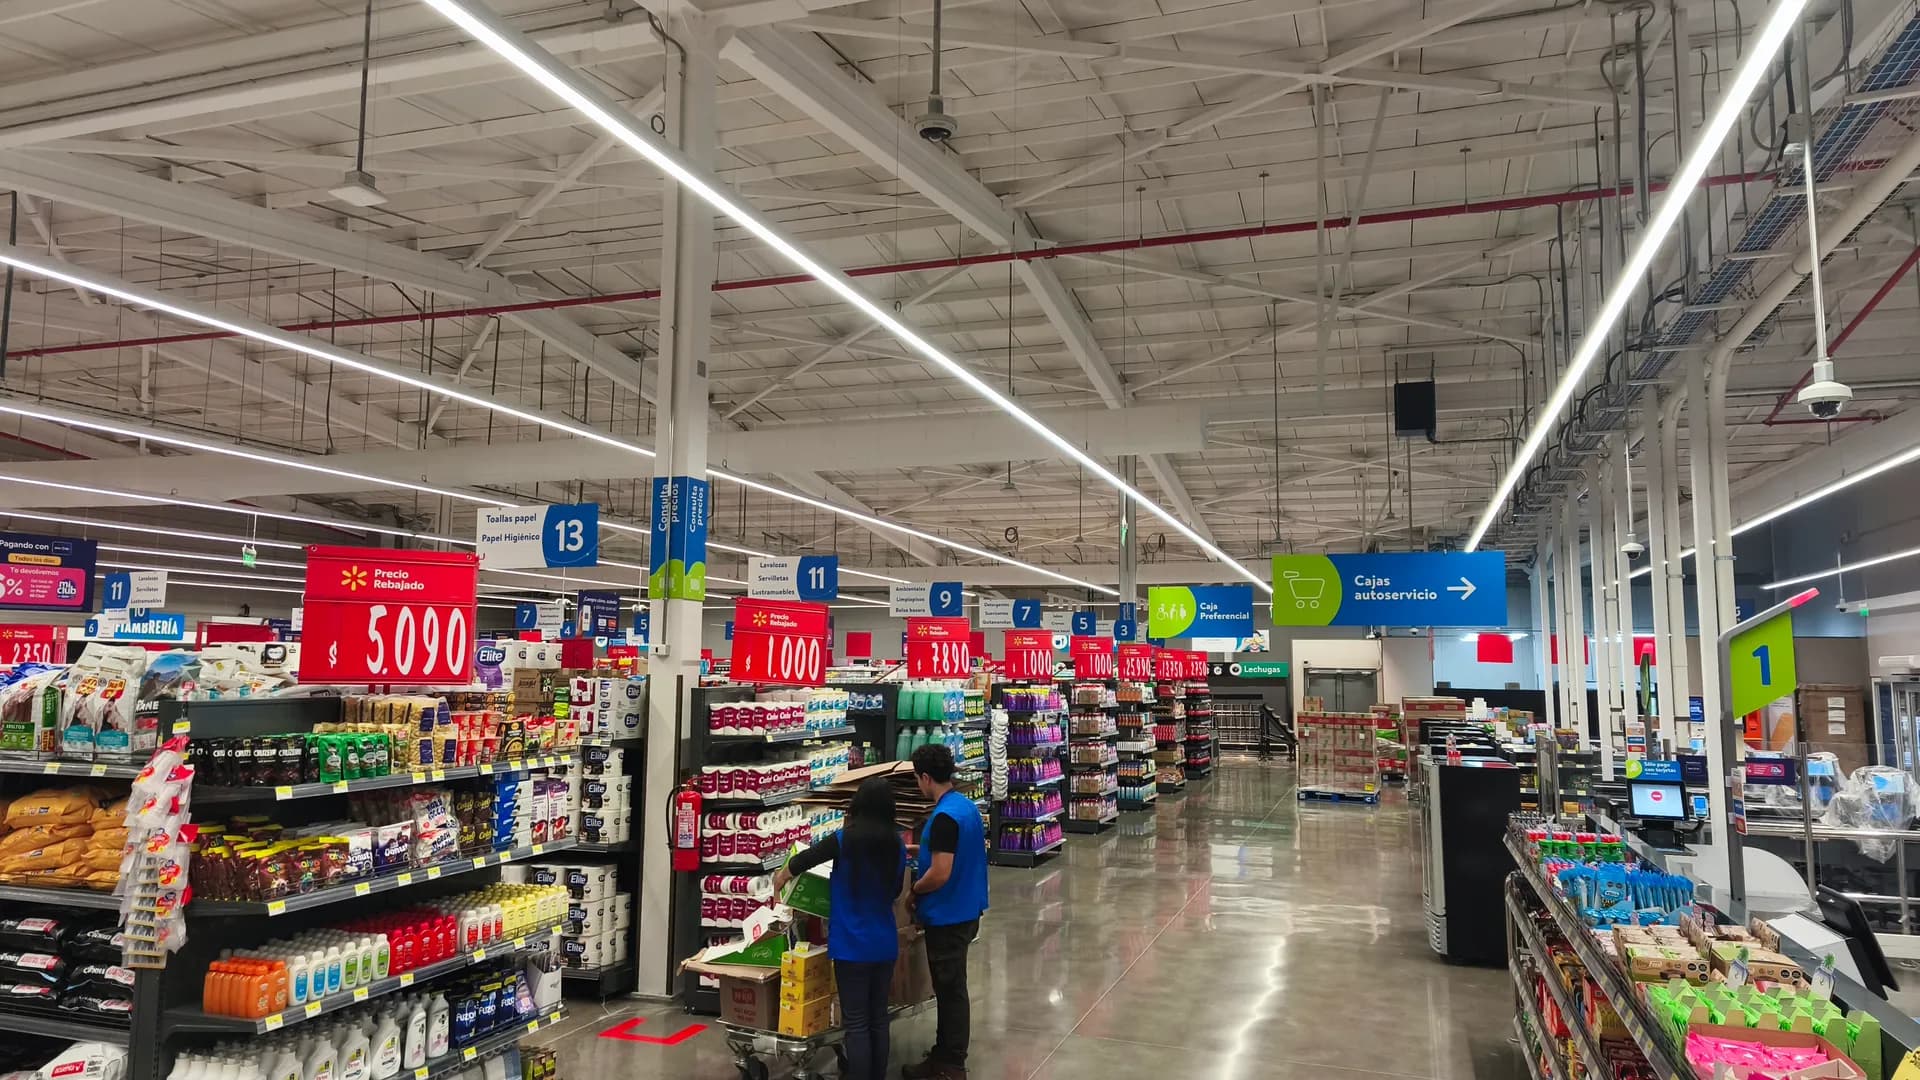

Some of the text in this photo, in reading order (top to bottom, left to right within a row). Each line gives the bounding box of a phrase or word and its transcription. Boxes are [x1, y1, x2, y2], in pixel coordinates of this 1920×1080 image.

[657, 483, 670, 532] Consulta
[671, 483, 680, 523] precios
[689, 485, 698, 533] Consulta
[486, 513, 537, 523] Toallas papel
[481, 532, 540, 543] Papel Higiénico
[555, 519, 584, 552] 13
[0, 539, 34, 550] Pagando
[35, 543, 50, 551] con
[760, 561, 788, 569] Lavalozas
[374, 569, 409, 579] Precio
[758, 574, 789, 582] Servilletas
[808, 566, 826, 590] 11
[373, 579, 425, 591] Rebajado
[1354, 575, 1391, 588] Cajas
[111, 581, 123, 600] 11
[751, 588, 795, 596] Lustramuebles
[1354, 589, 1438, 601] autoservicio
[939, 590, 952, 609] 9
[1200, 602, 1218, 611] Caja
[522, 610, 531, 624] 7
[769, 612, 790, 621] Precio
[1021, 606, 1032, 622] 7
[1200, 611, 1250, 620] Preferencial
[88, 623, 95, 633] 6
[640, 619, 648, 630] 5
[769, 619, 798, 628] Rebajado
[1079, 617, 1089, 630] 5
[563, 627, 571, 636] 4
[1120, 624, 1128, 636] 3
[328, 604, 467, 676] $ 5.090
[479, 650, 503, 663] Elite
[767, 634, 820, 682] 1.000
[931, 641, 970, 675] 7.890
[1243, 664, 1281, 675] Lechugas
[1752, 644, 1772, 686] 1
[590, 751, 608, 760] Elite
[588, 784, 606, 793] Elite
[585, 818, 602, 827] Elite
[537, 873, 555, 883] Elite
[570, 874, 586, 884] Elite
[569, 910, 586, 920] Elite
[566, 942, 584, 953] Elite
